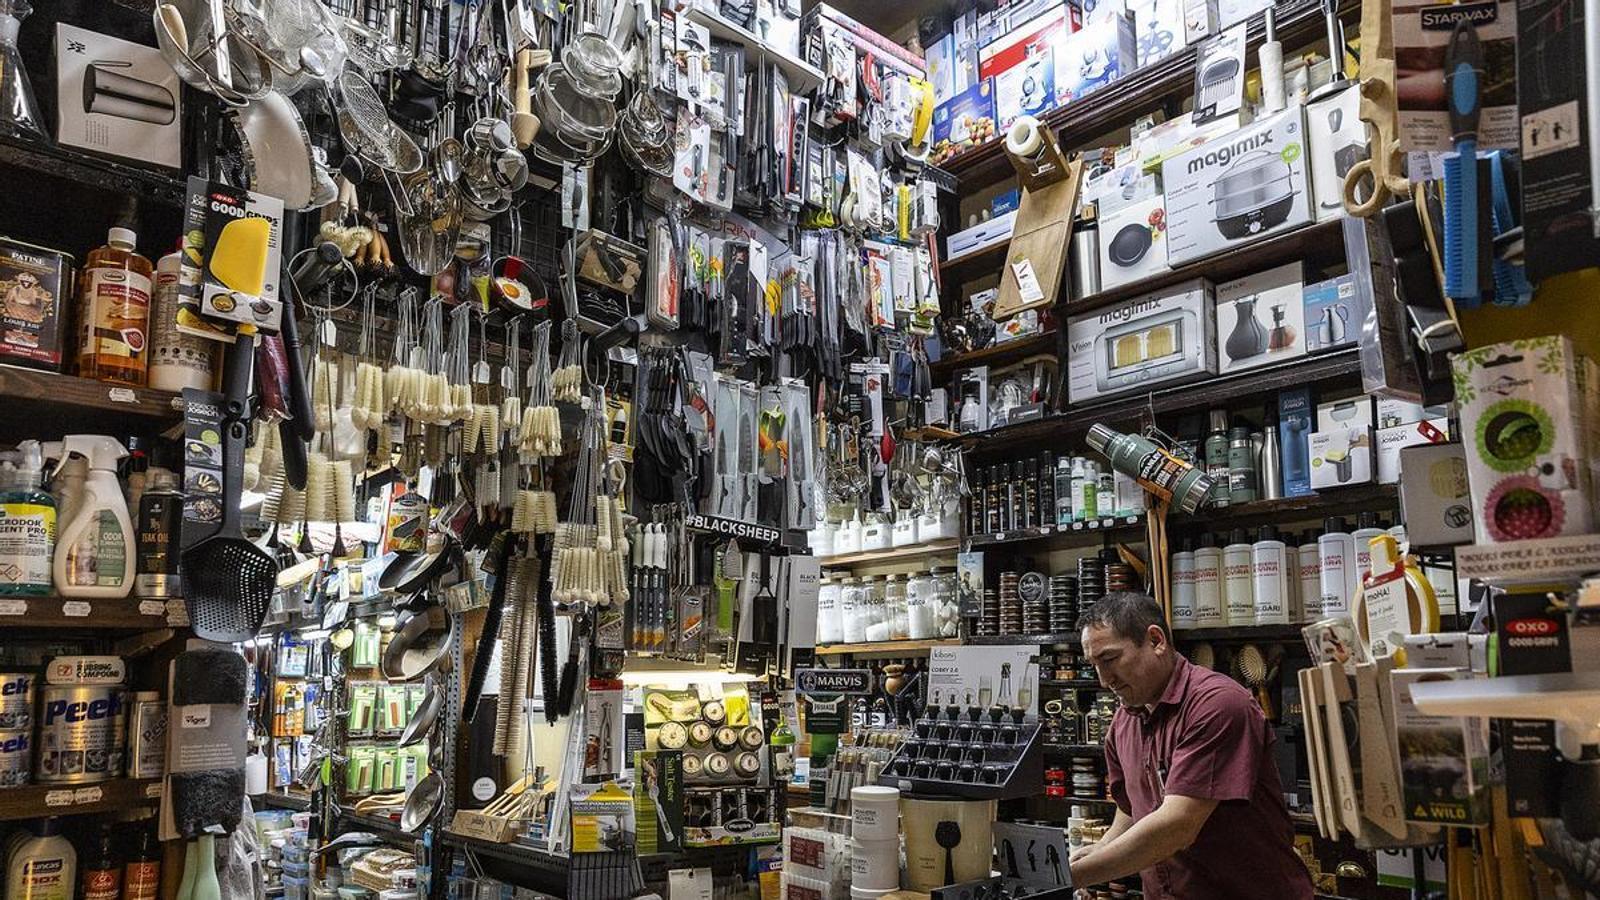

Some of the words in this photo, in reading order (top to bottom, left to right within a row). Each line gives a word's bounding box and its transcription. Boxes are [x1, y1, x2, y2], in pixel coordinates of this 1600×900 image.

[1423, 7, 1494, 26] STARWAX
[1187, 129, 1273, 174] magimix
[211, 201, 245, 218] GOOD
[1099, 296, 1162, 325] magimix
[686, 514, 779, 542] #BLACKSHEEP
[1515, 621, 1549, 633] OXO
[818, 676, 862, 687] MARVIS
[46, 691, 122, 726] Peek
[665, 757, 676, 776] Salt
[1429, 806, 1467, 820] WILD
